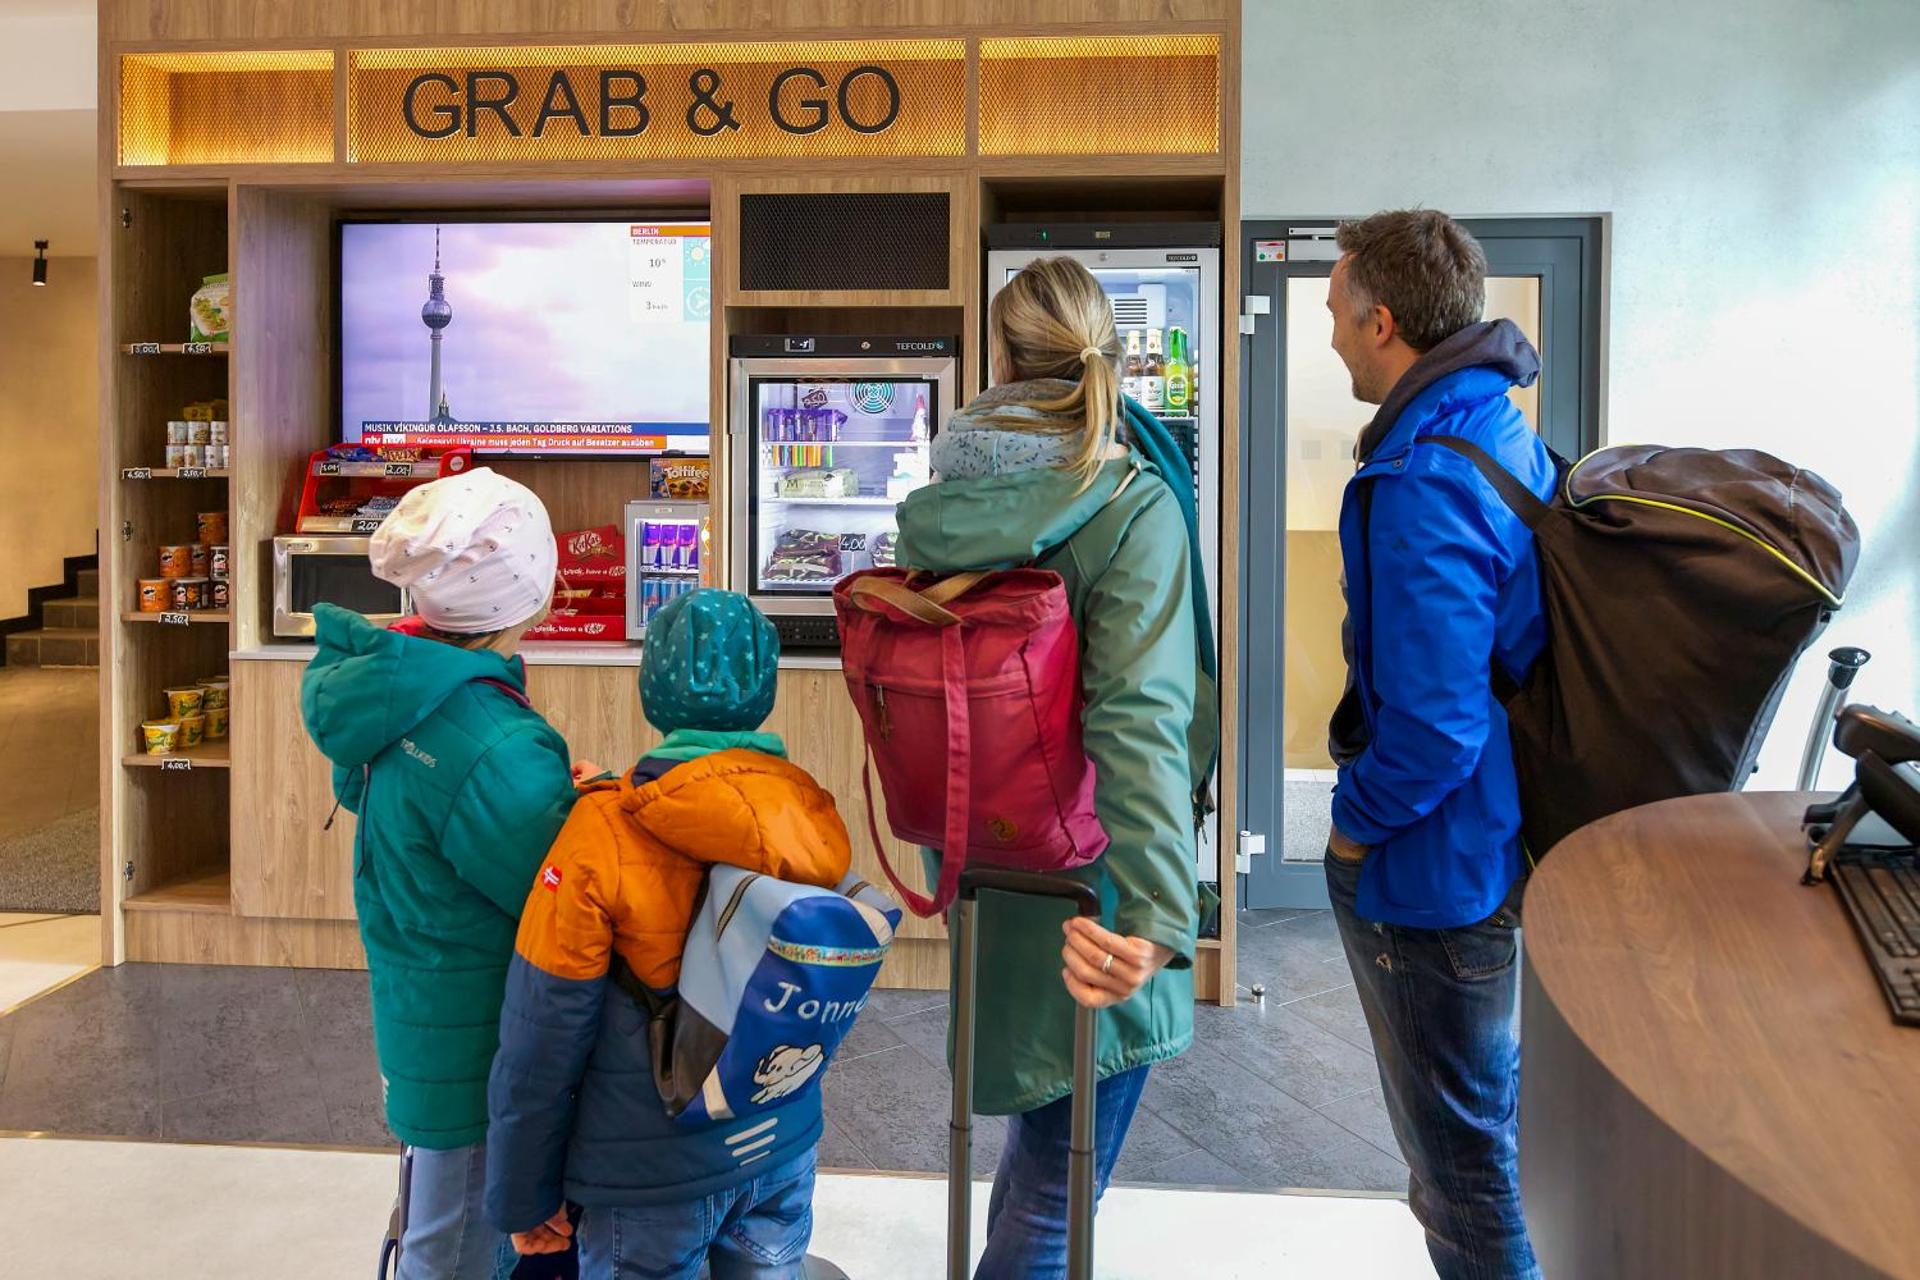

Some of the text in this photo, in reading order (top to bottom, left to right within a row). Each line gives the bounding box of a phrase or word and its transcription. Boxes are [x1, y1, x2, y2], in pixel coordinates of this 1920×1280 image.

[402, 65, 902, 139] GRAB & GO
[895, 341, 935, 351] TEFCOLD
[364, 422, 393, 433] MUSIK
[437, 421, 481, 433] ÓLAFSSON
[506, 423, 533, 434] BACH,
[533, 423, 579, 434] GOLDBERG
[580, 423, 633, 434] VARIATIONS
[509, 437, 531, 447] jeden
[532, 437, 546, 448] Tag
[548, 437, 570, 446] Druck
[571, 438, 586, 446] auf
[586, 438, 620, 446] Besatzer
[585, 567, 601, 576] have
[558, 624, 577, 633] have
